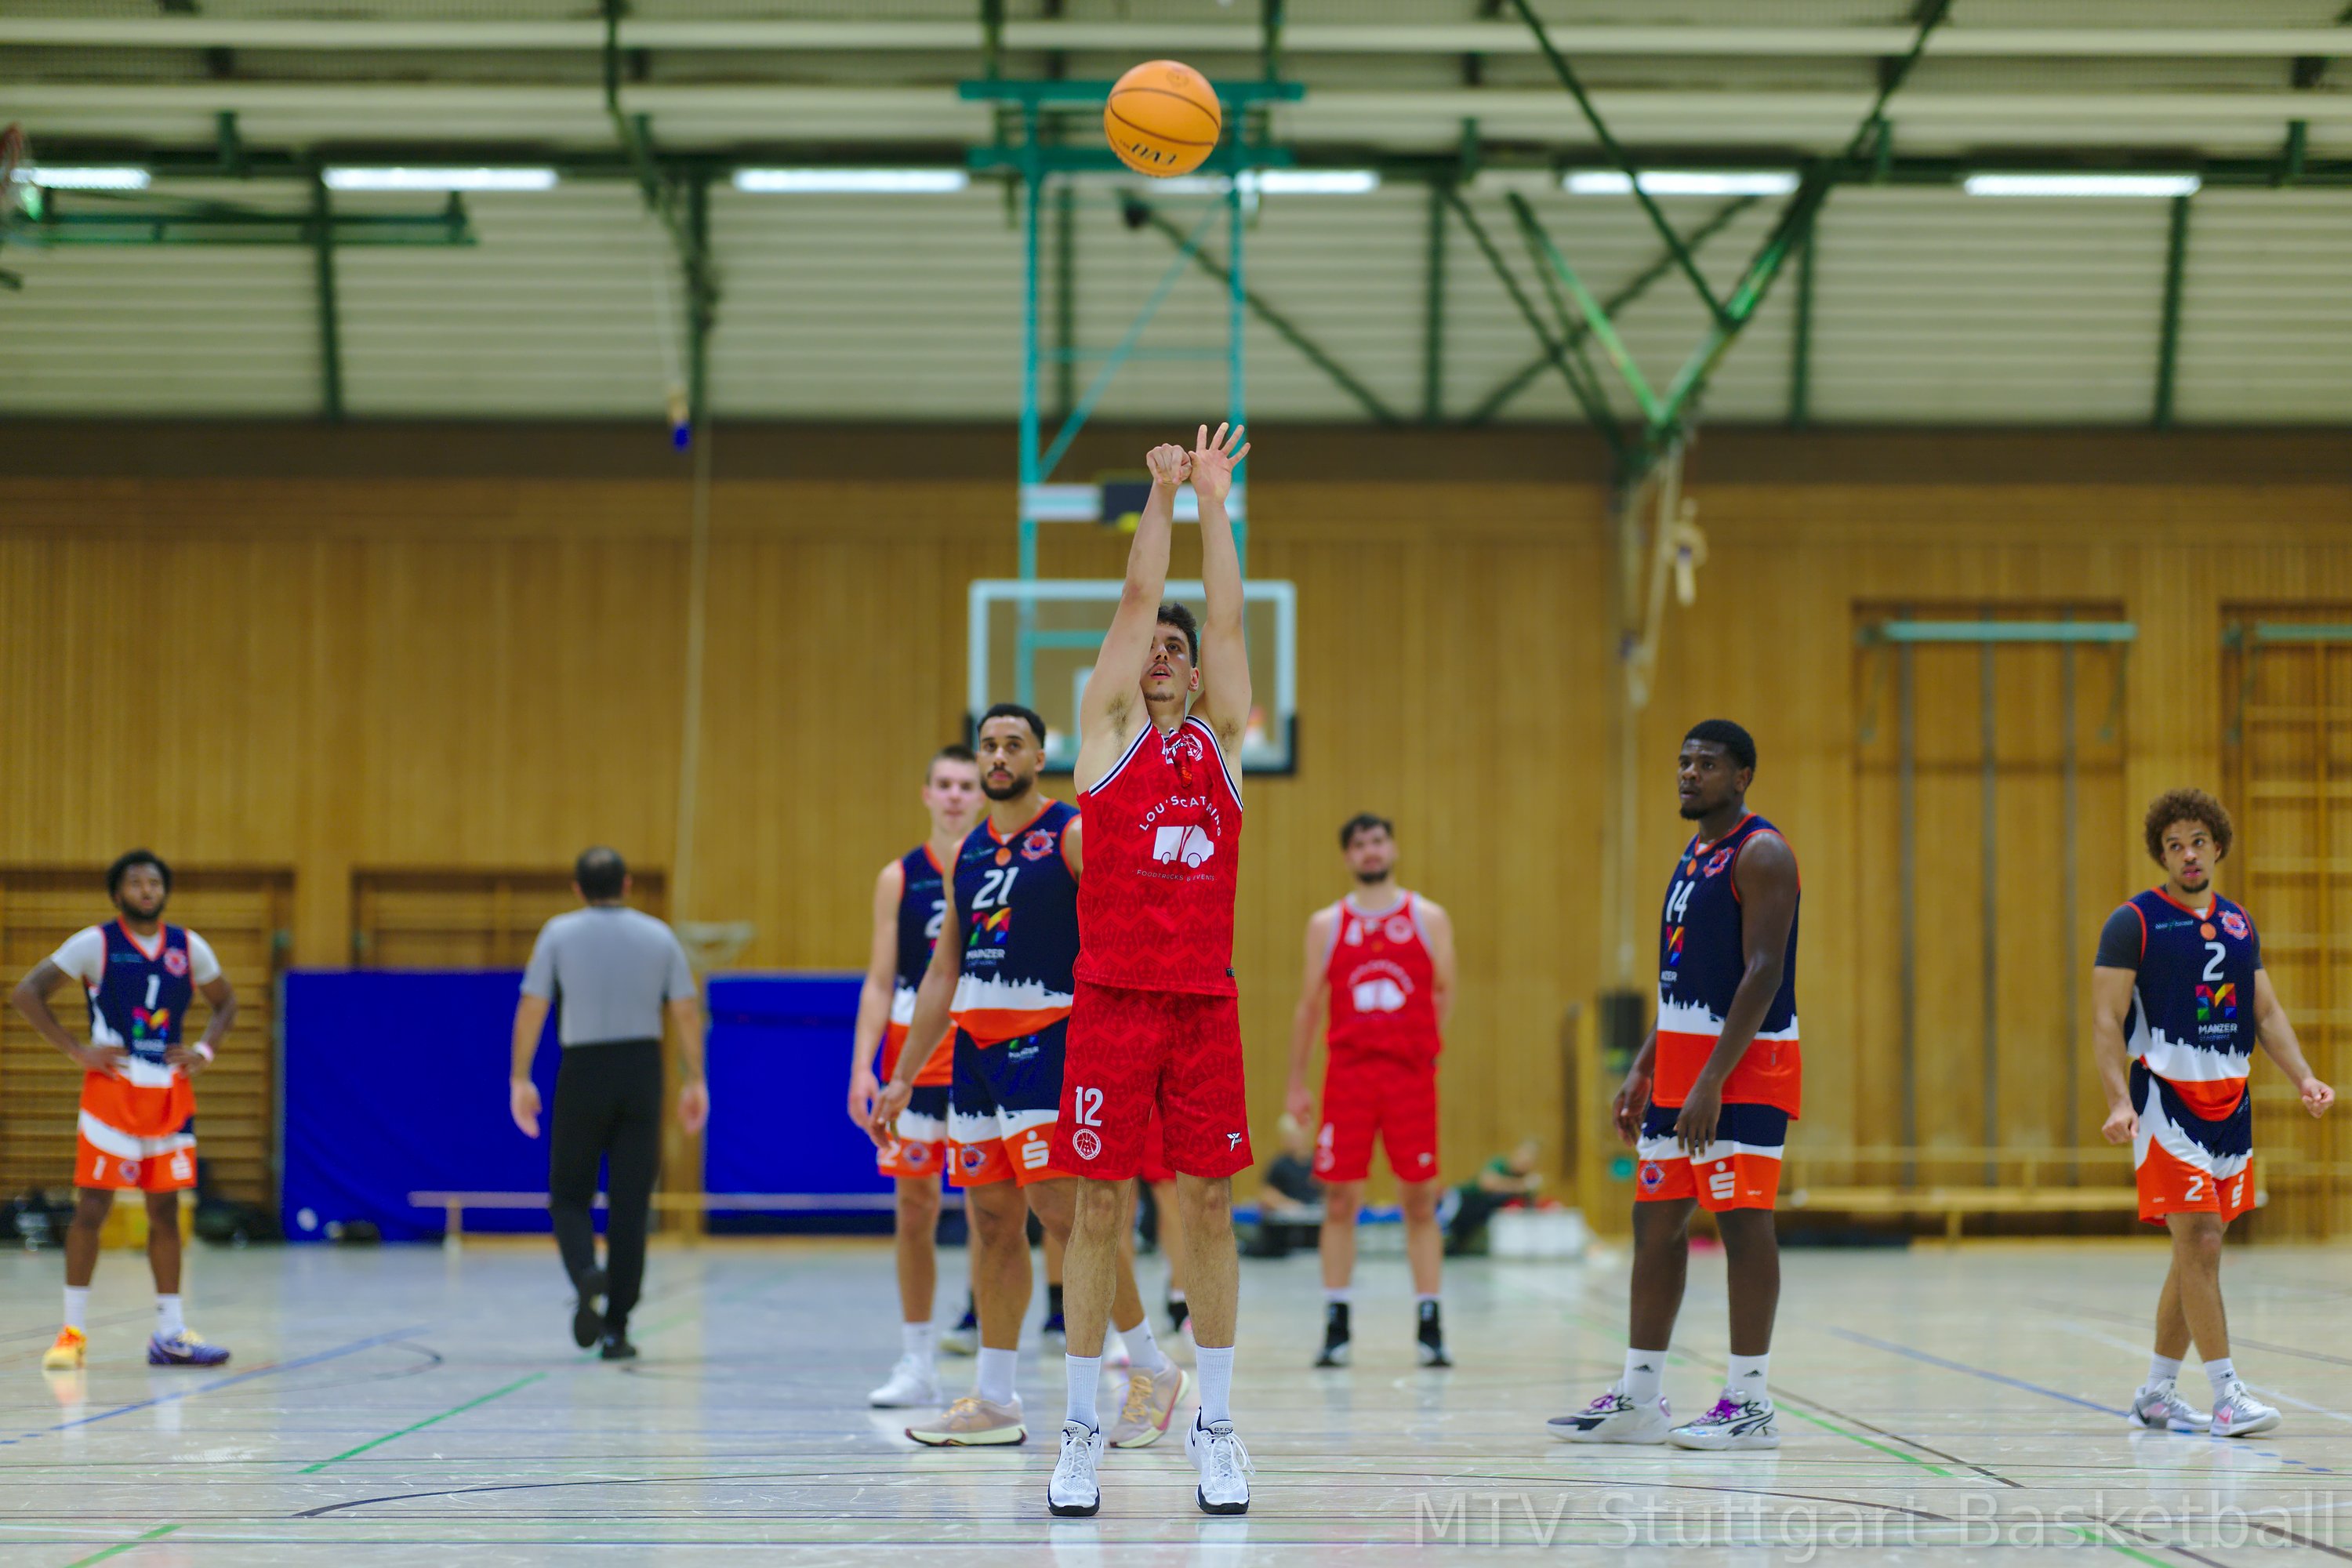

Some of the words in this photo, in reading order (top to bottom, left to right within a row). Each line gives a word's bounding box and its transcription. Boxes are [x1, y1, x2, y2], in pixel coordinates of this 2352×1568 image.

[971, 866, 1019, 910] 21
[1665, 880, 1696, 923] 14
[2202, 942, 2227, 982] 2
[145, 975, 161, 1010] 1
[1075, 1086, 1104, 1127] 12
[2184, 1176, 2204, 1201] 2
